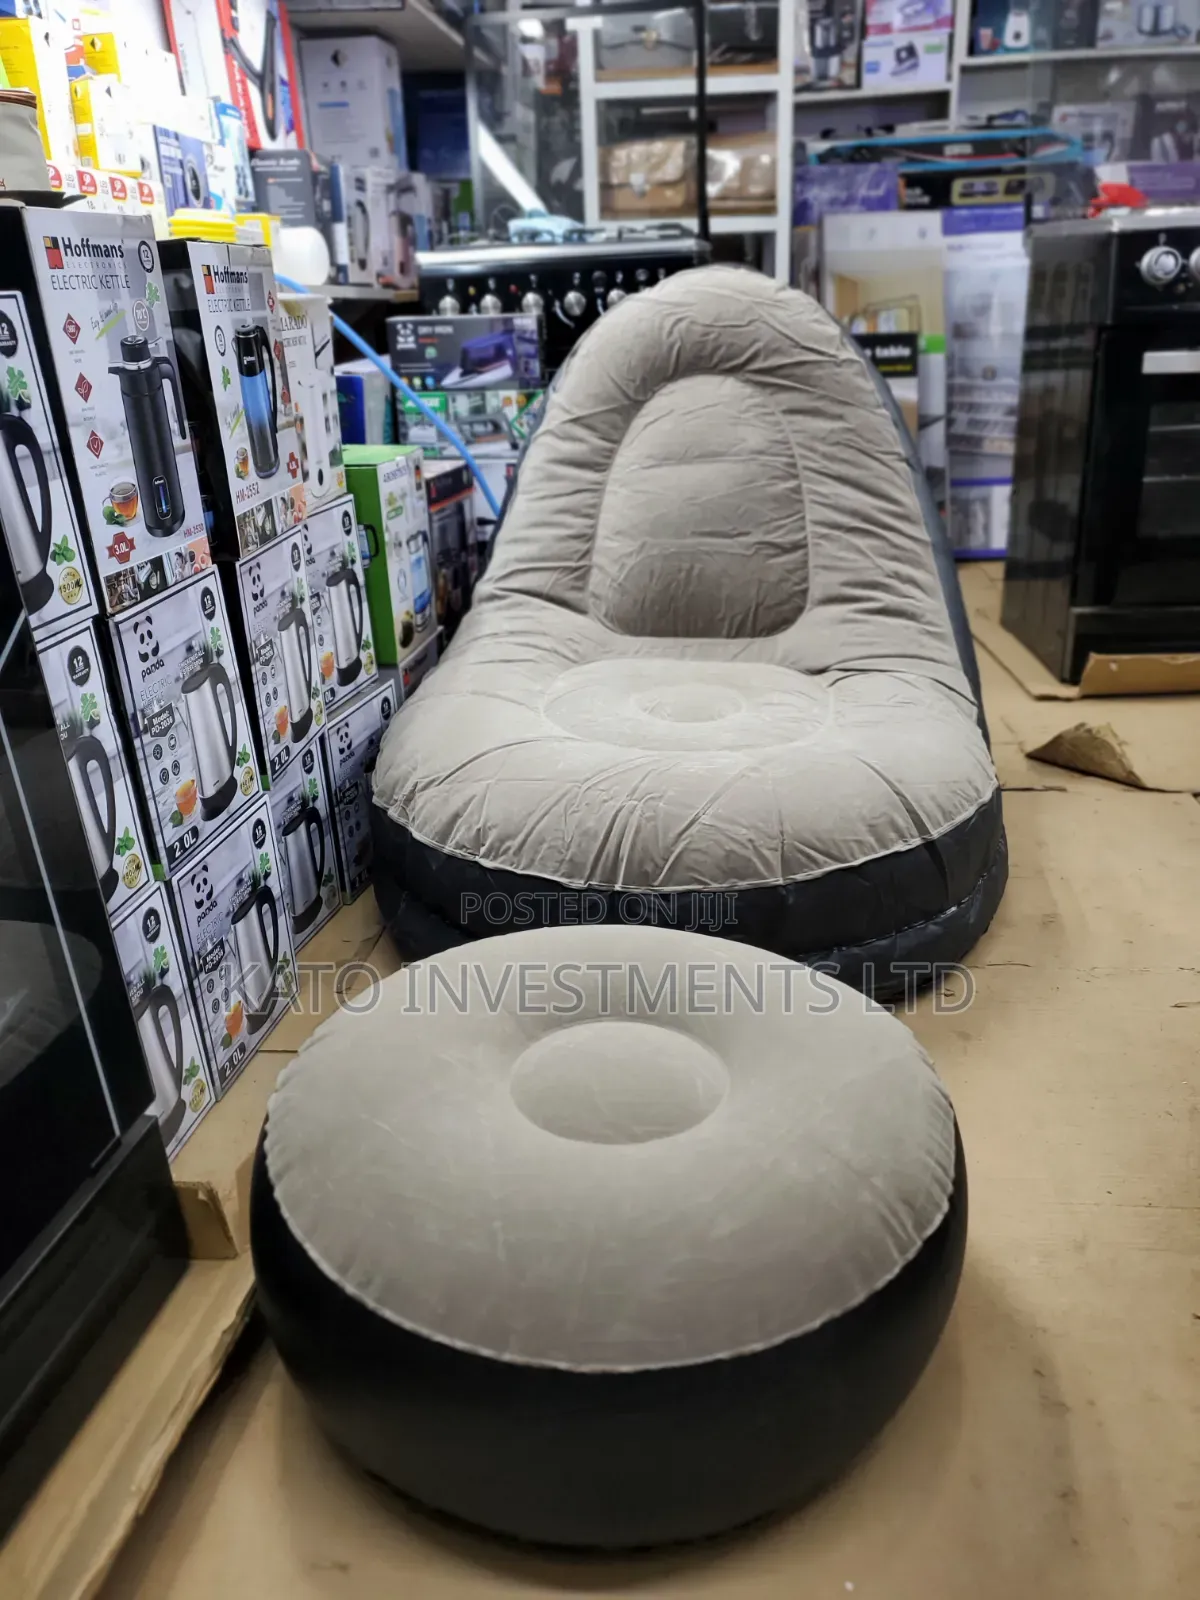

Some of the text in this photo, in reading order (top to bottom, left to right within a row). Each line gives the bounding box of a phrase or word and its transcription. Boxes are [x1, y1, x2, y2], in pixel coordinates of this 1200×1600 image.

[61, 237, 124, 258] Hoffmans
[50, 275, 130, 290] ELECTRIC KETTLE
[212, 265, 249, 284] Hoffmans
[114, 542, 130, 555] 3.0L
[73, 655, 84, 669] 12
[141, 659, 165, 682] panda
[60, 722, 70, 731] ALL
[196, 900, 218, 927] panda
[224, 1047, 244, 1077] 2.0L
